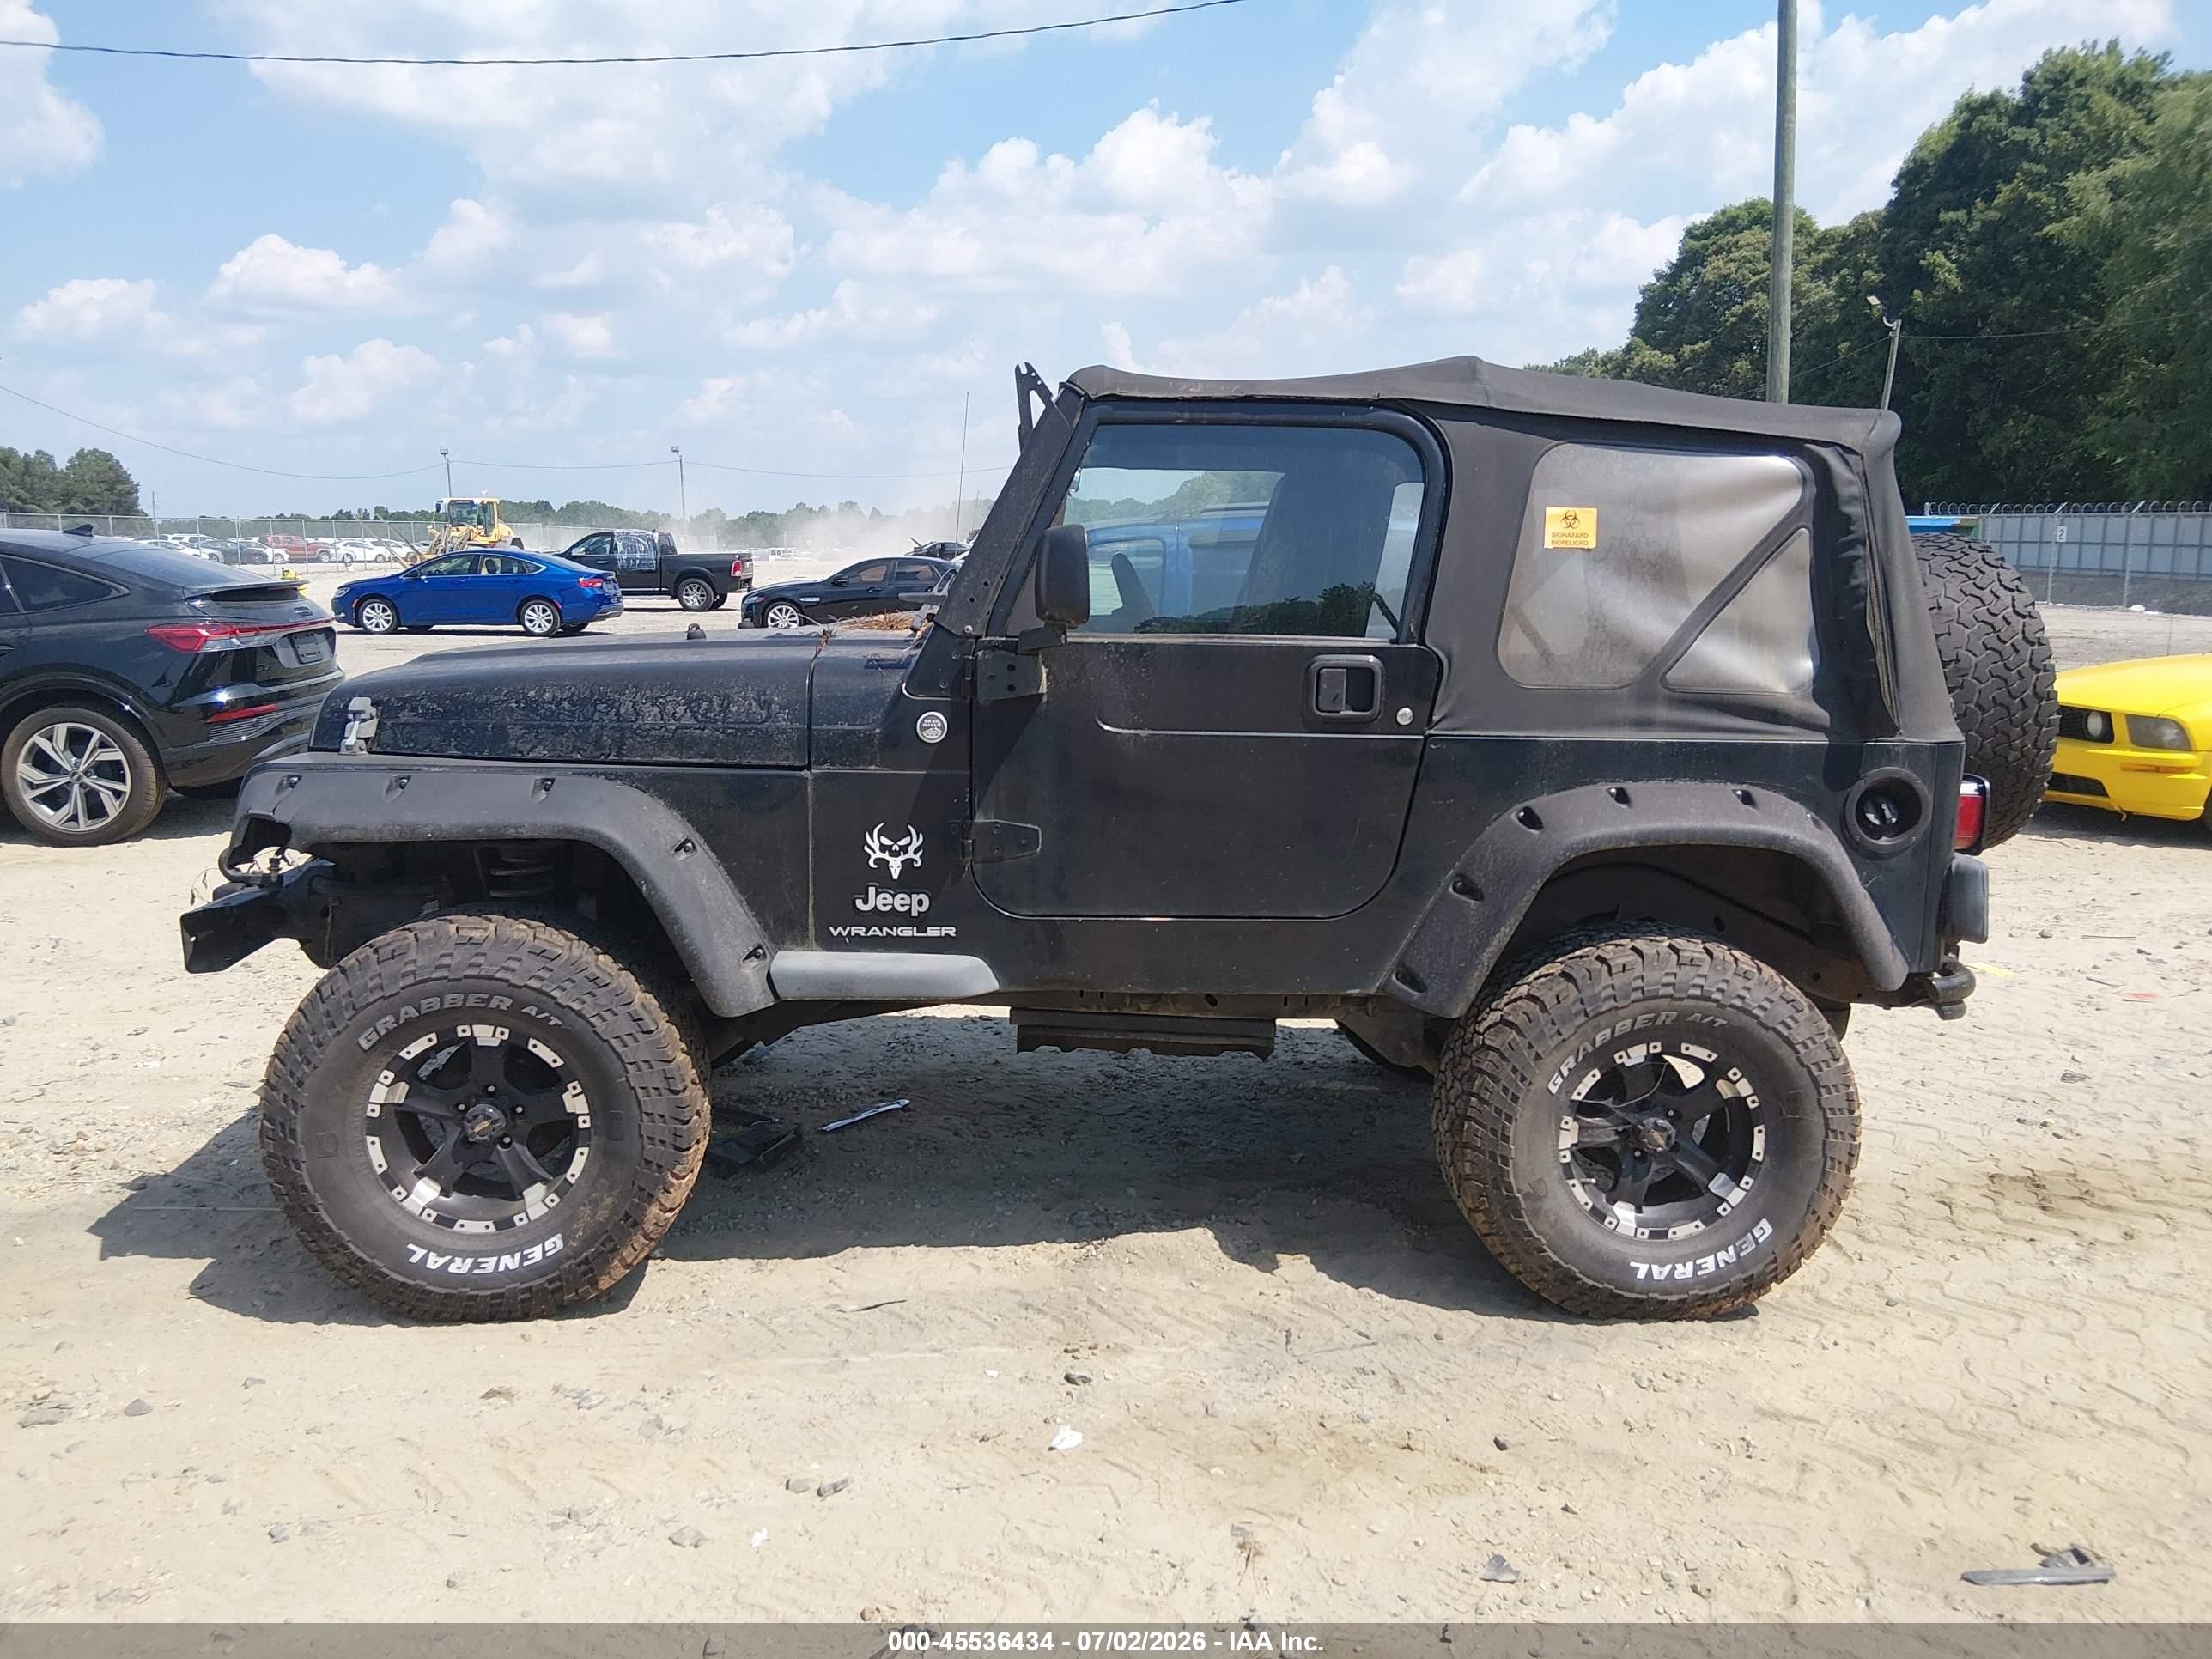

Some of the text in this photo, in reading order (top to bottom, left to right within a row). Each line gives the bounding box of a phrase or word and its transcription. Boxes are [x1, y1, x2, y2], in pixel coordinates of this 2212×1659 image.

[855, 885, 930, 917] Jeep
[829, 926, 957, 937] WRANGLER
[357, 993, 564, 1051] GRABBER A/T
[1547, 1011, 1731, 1096] GRABBER A/T
[406, 1233, 565, 1275] GENERAL
[1628, 1218, 1773, 1280] GENERAL
